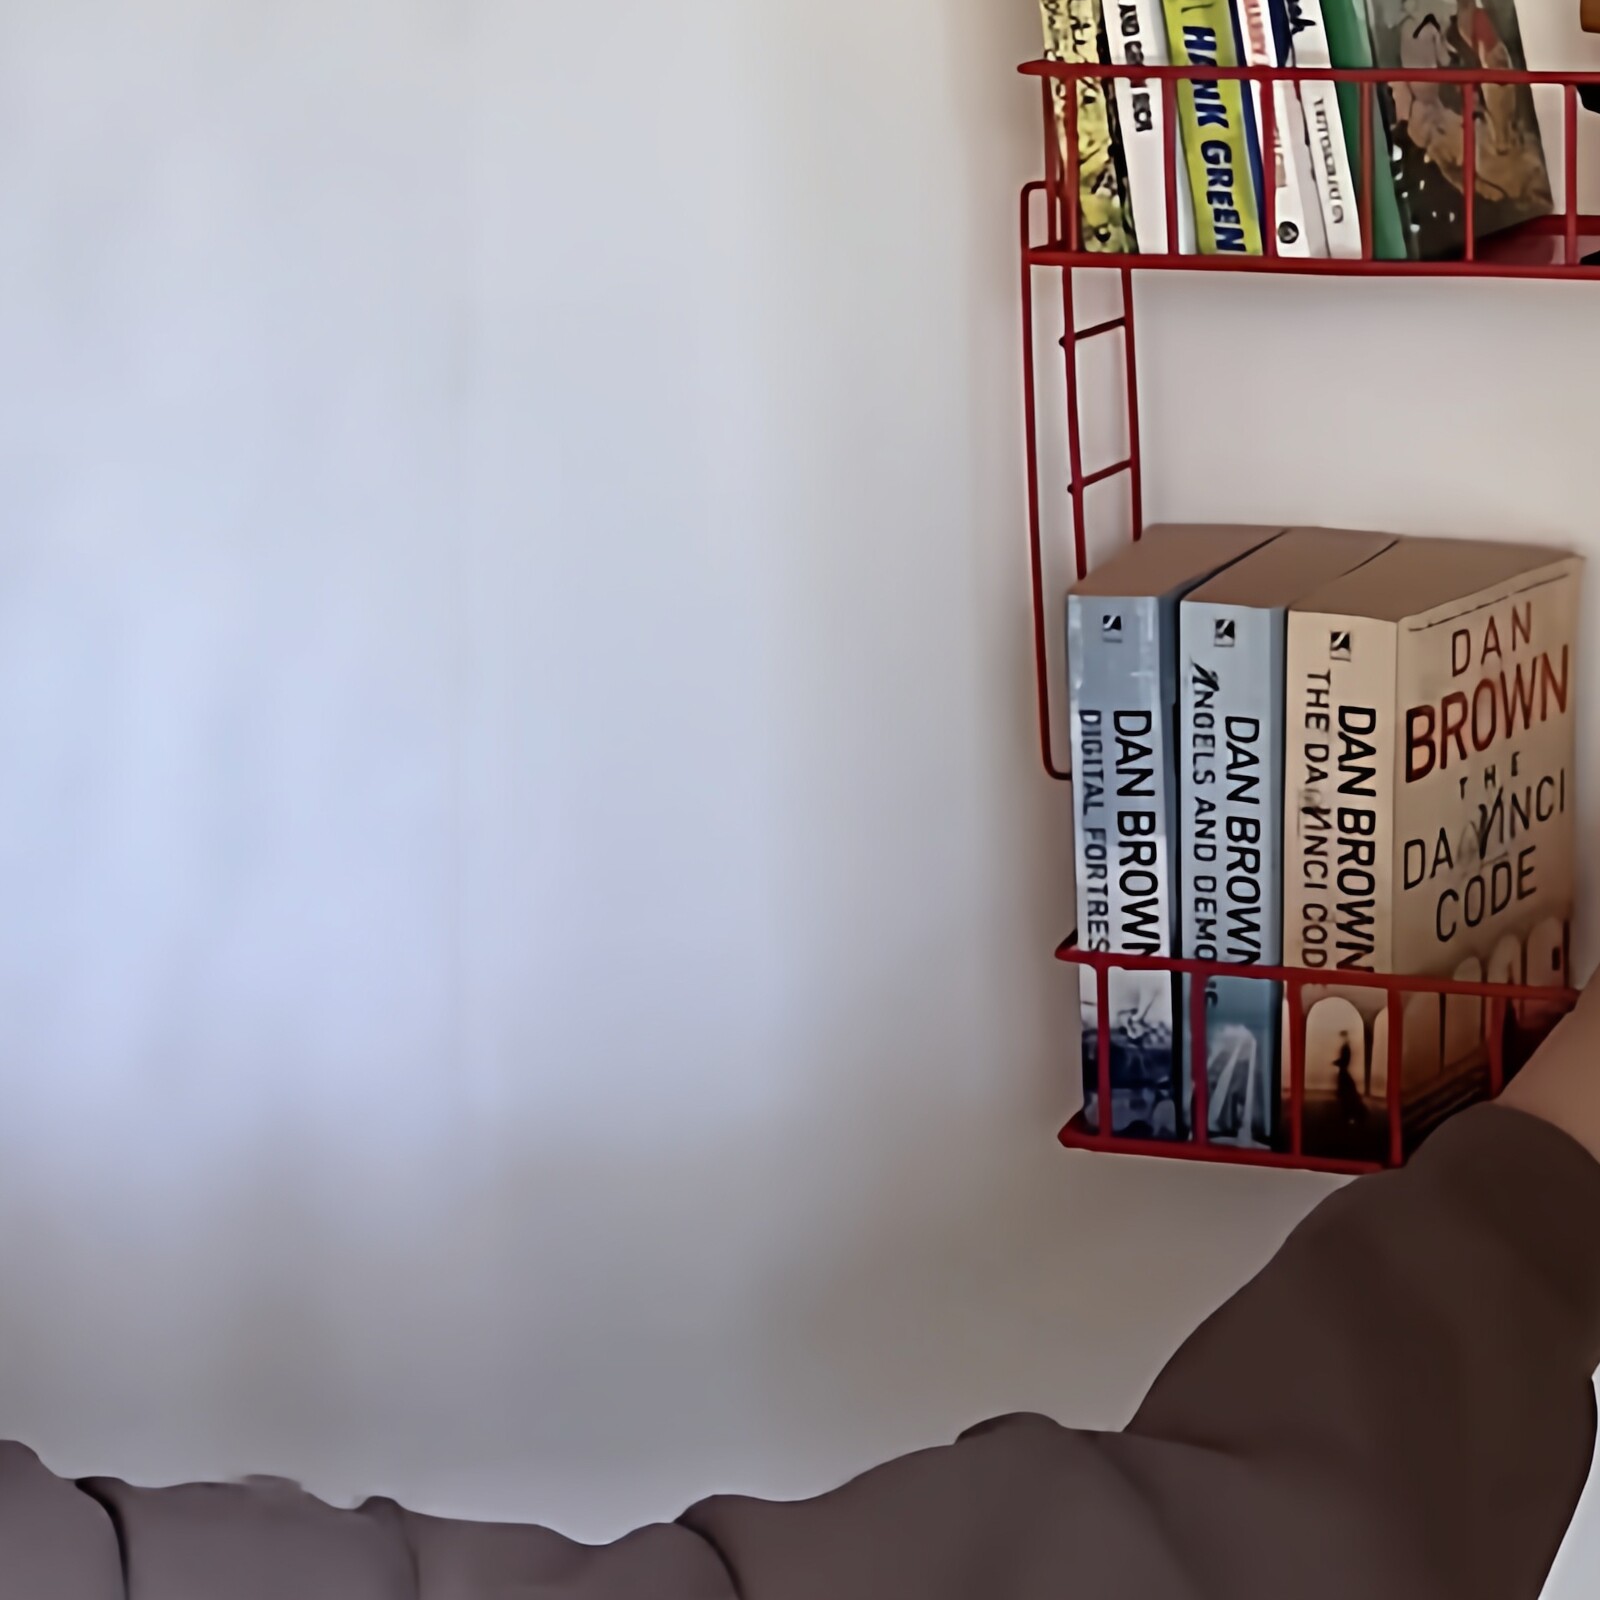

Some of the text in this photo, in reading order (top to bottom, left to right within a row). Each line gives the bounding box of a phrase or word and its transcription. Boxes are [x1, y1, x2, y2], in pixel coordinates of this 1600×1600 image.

[1182, 25, 1248, 253] HANK GREEN
[1451, 601, 1532, 677] DAN
[1112, 709, 1156, 797] DAN
[1190, 658, 1220, 786] ANGELS
[1224, 715, 1261, 805] DAN
[1405, 643, 1570, 784] BROWN
[1459, 750, 1522, 800] THE
[1078, 709, 1111, 953] DIGITAL FORTRES
[1194, 796, 1218, 862] AND
[1300, 668, 1333, 969] THE DA VINCI COD
[1335, 705, 1378, 973] DAN BROWN
[1403, 766, 1566, 891] DA VINCI
[1435, 844, 1538, 943] CODE
